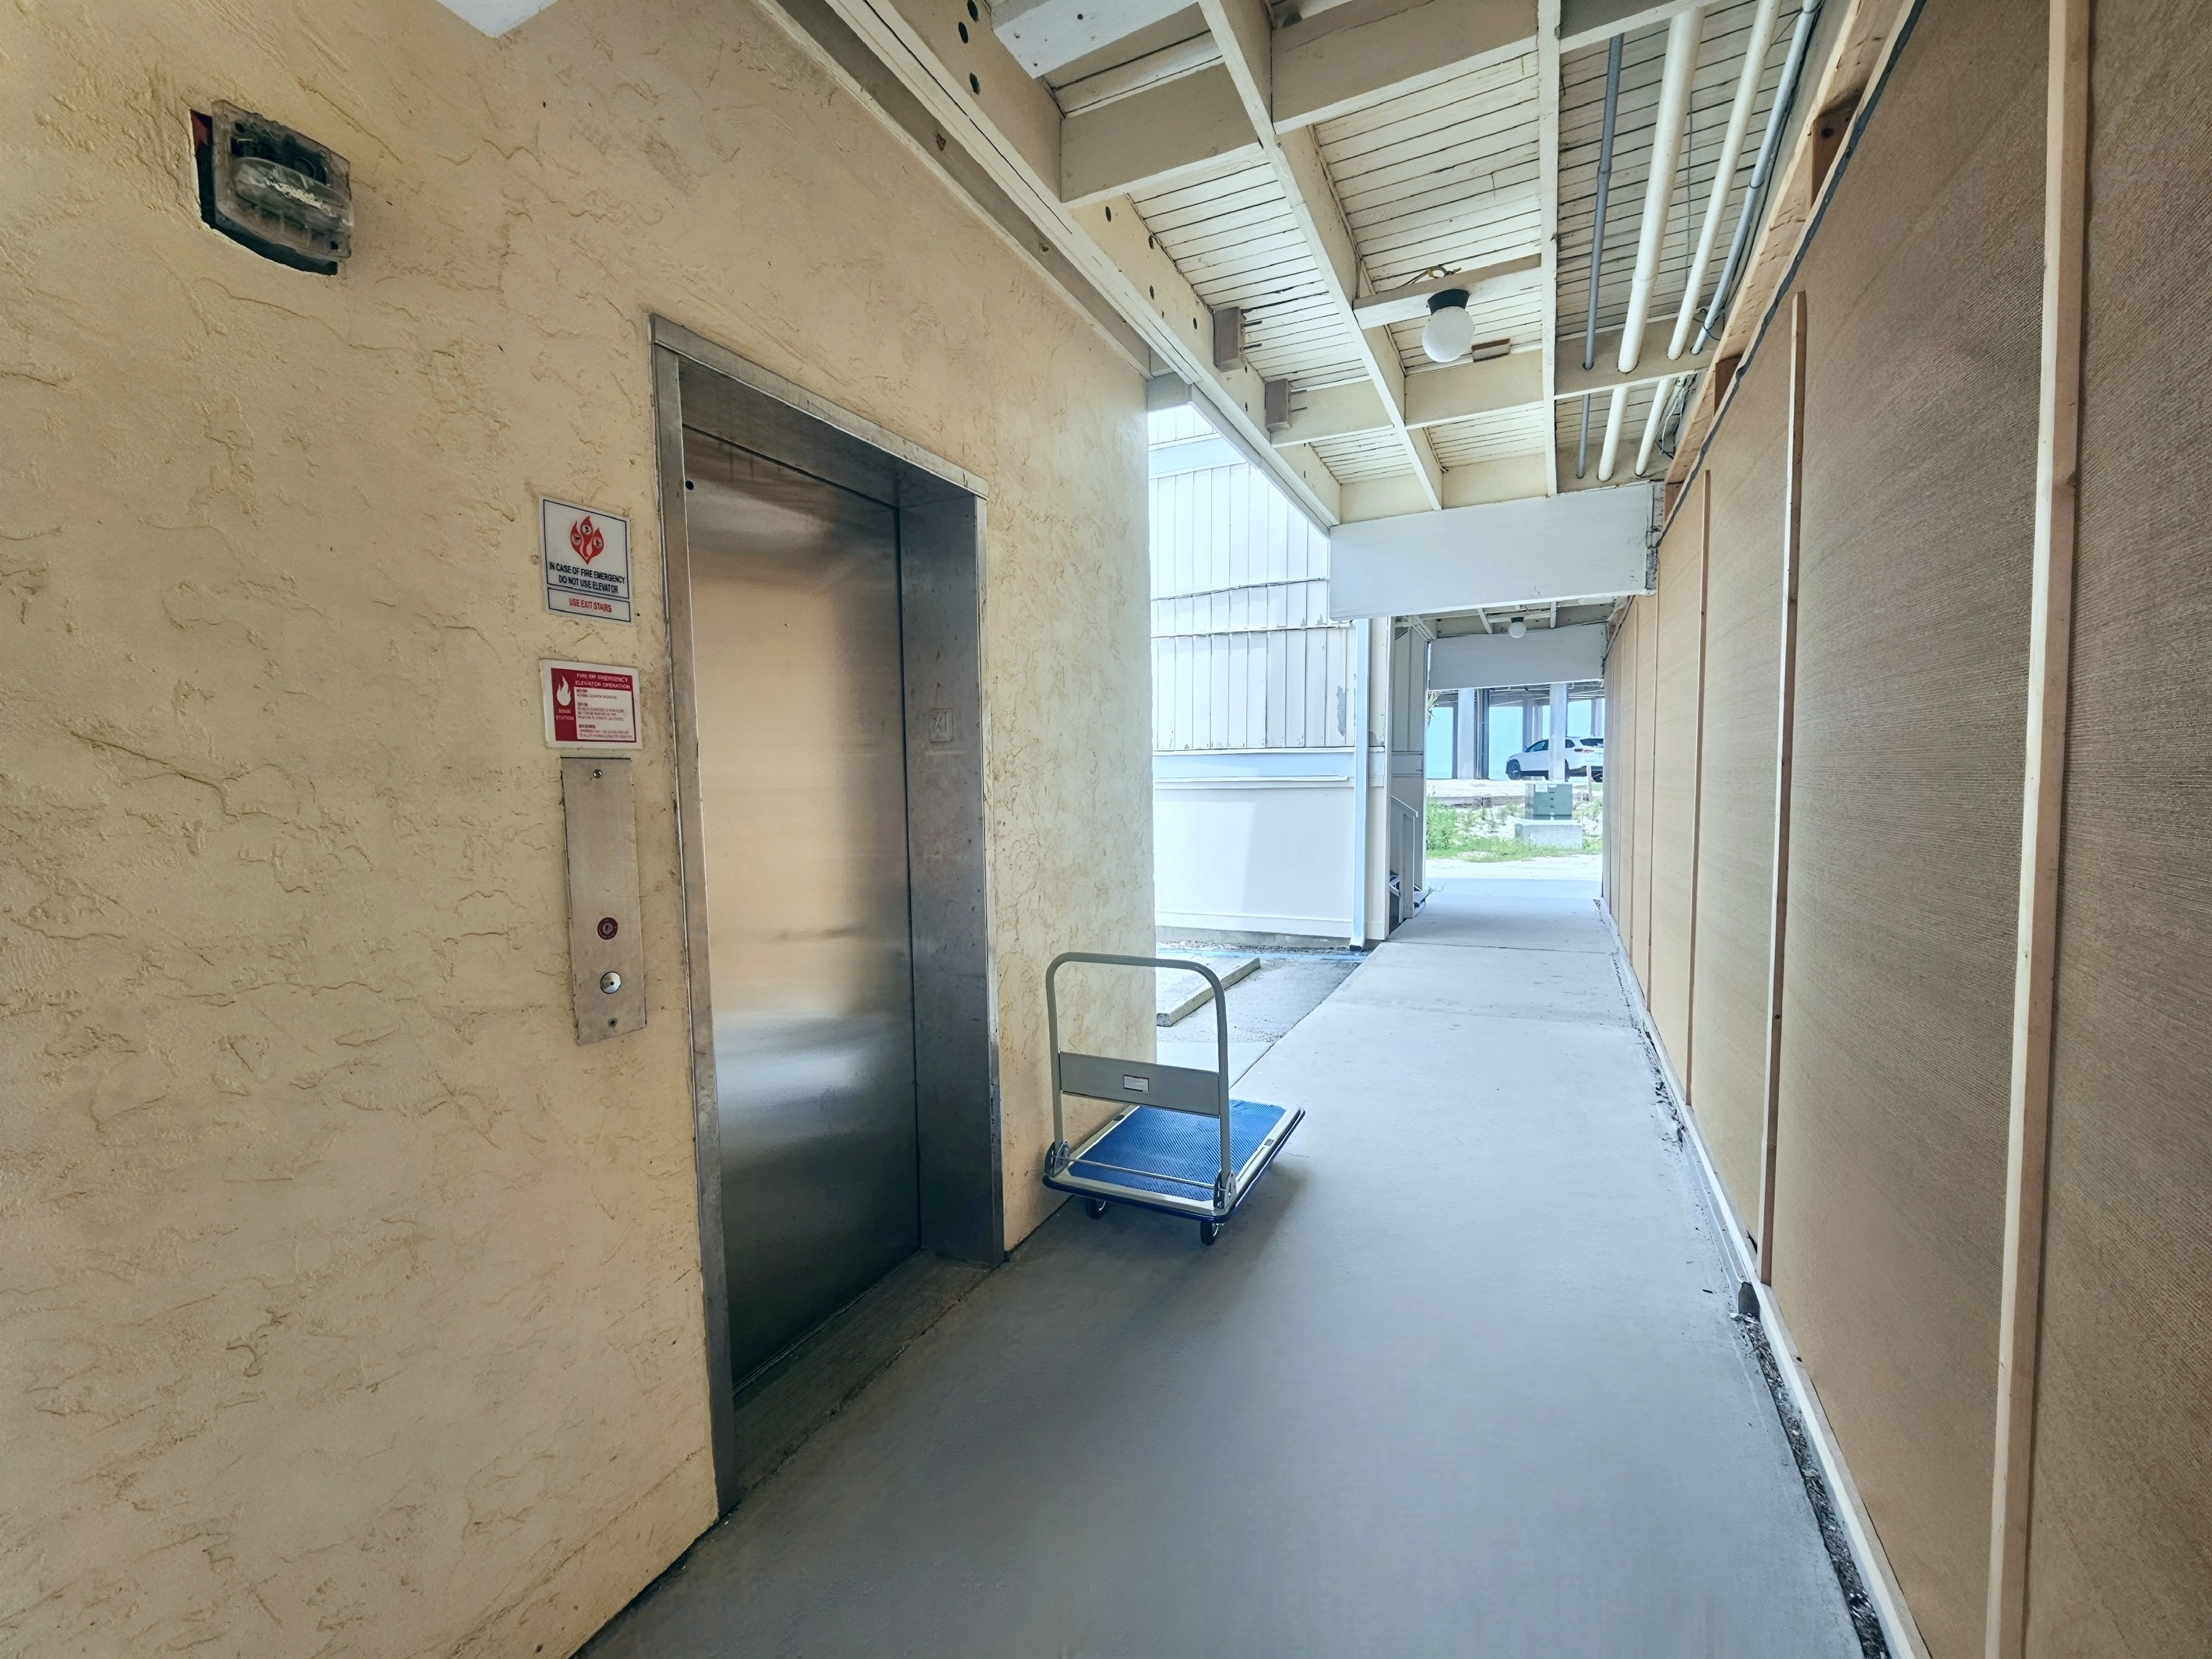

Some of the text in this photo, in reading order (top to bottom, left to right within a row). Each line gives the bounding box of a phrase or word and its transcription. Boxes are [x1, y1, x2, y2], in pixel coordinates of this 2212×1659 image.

[549, 562, 625, 583] IN CASE OF FIRE EMERGENCY
[558, 575, 618, 594] DO NOT USE ELEVATOR
[569, 598, 612, 613] USE EXIT STAIRS
